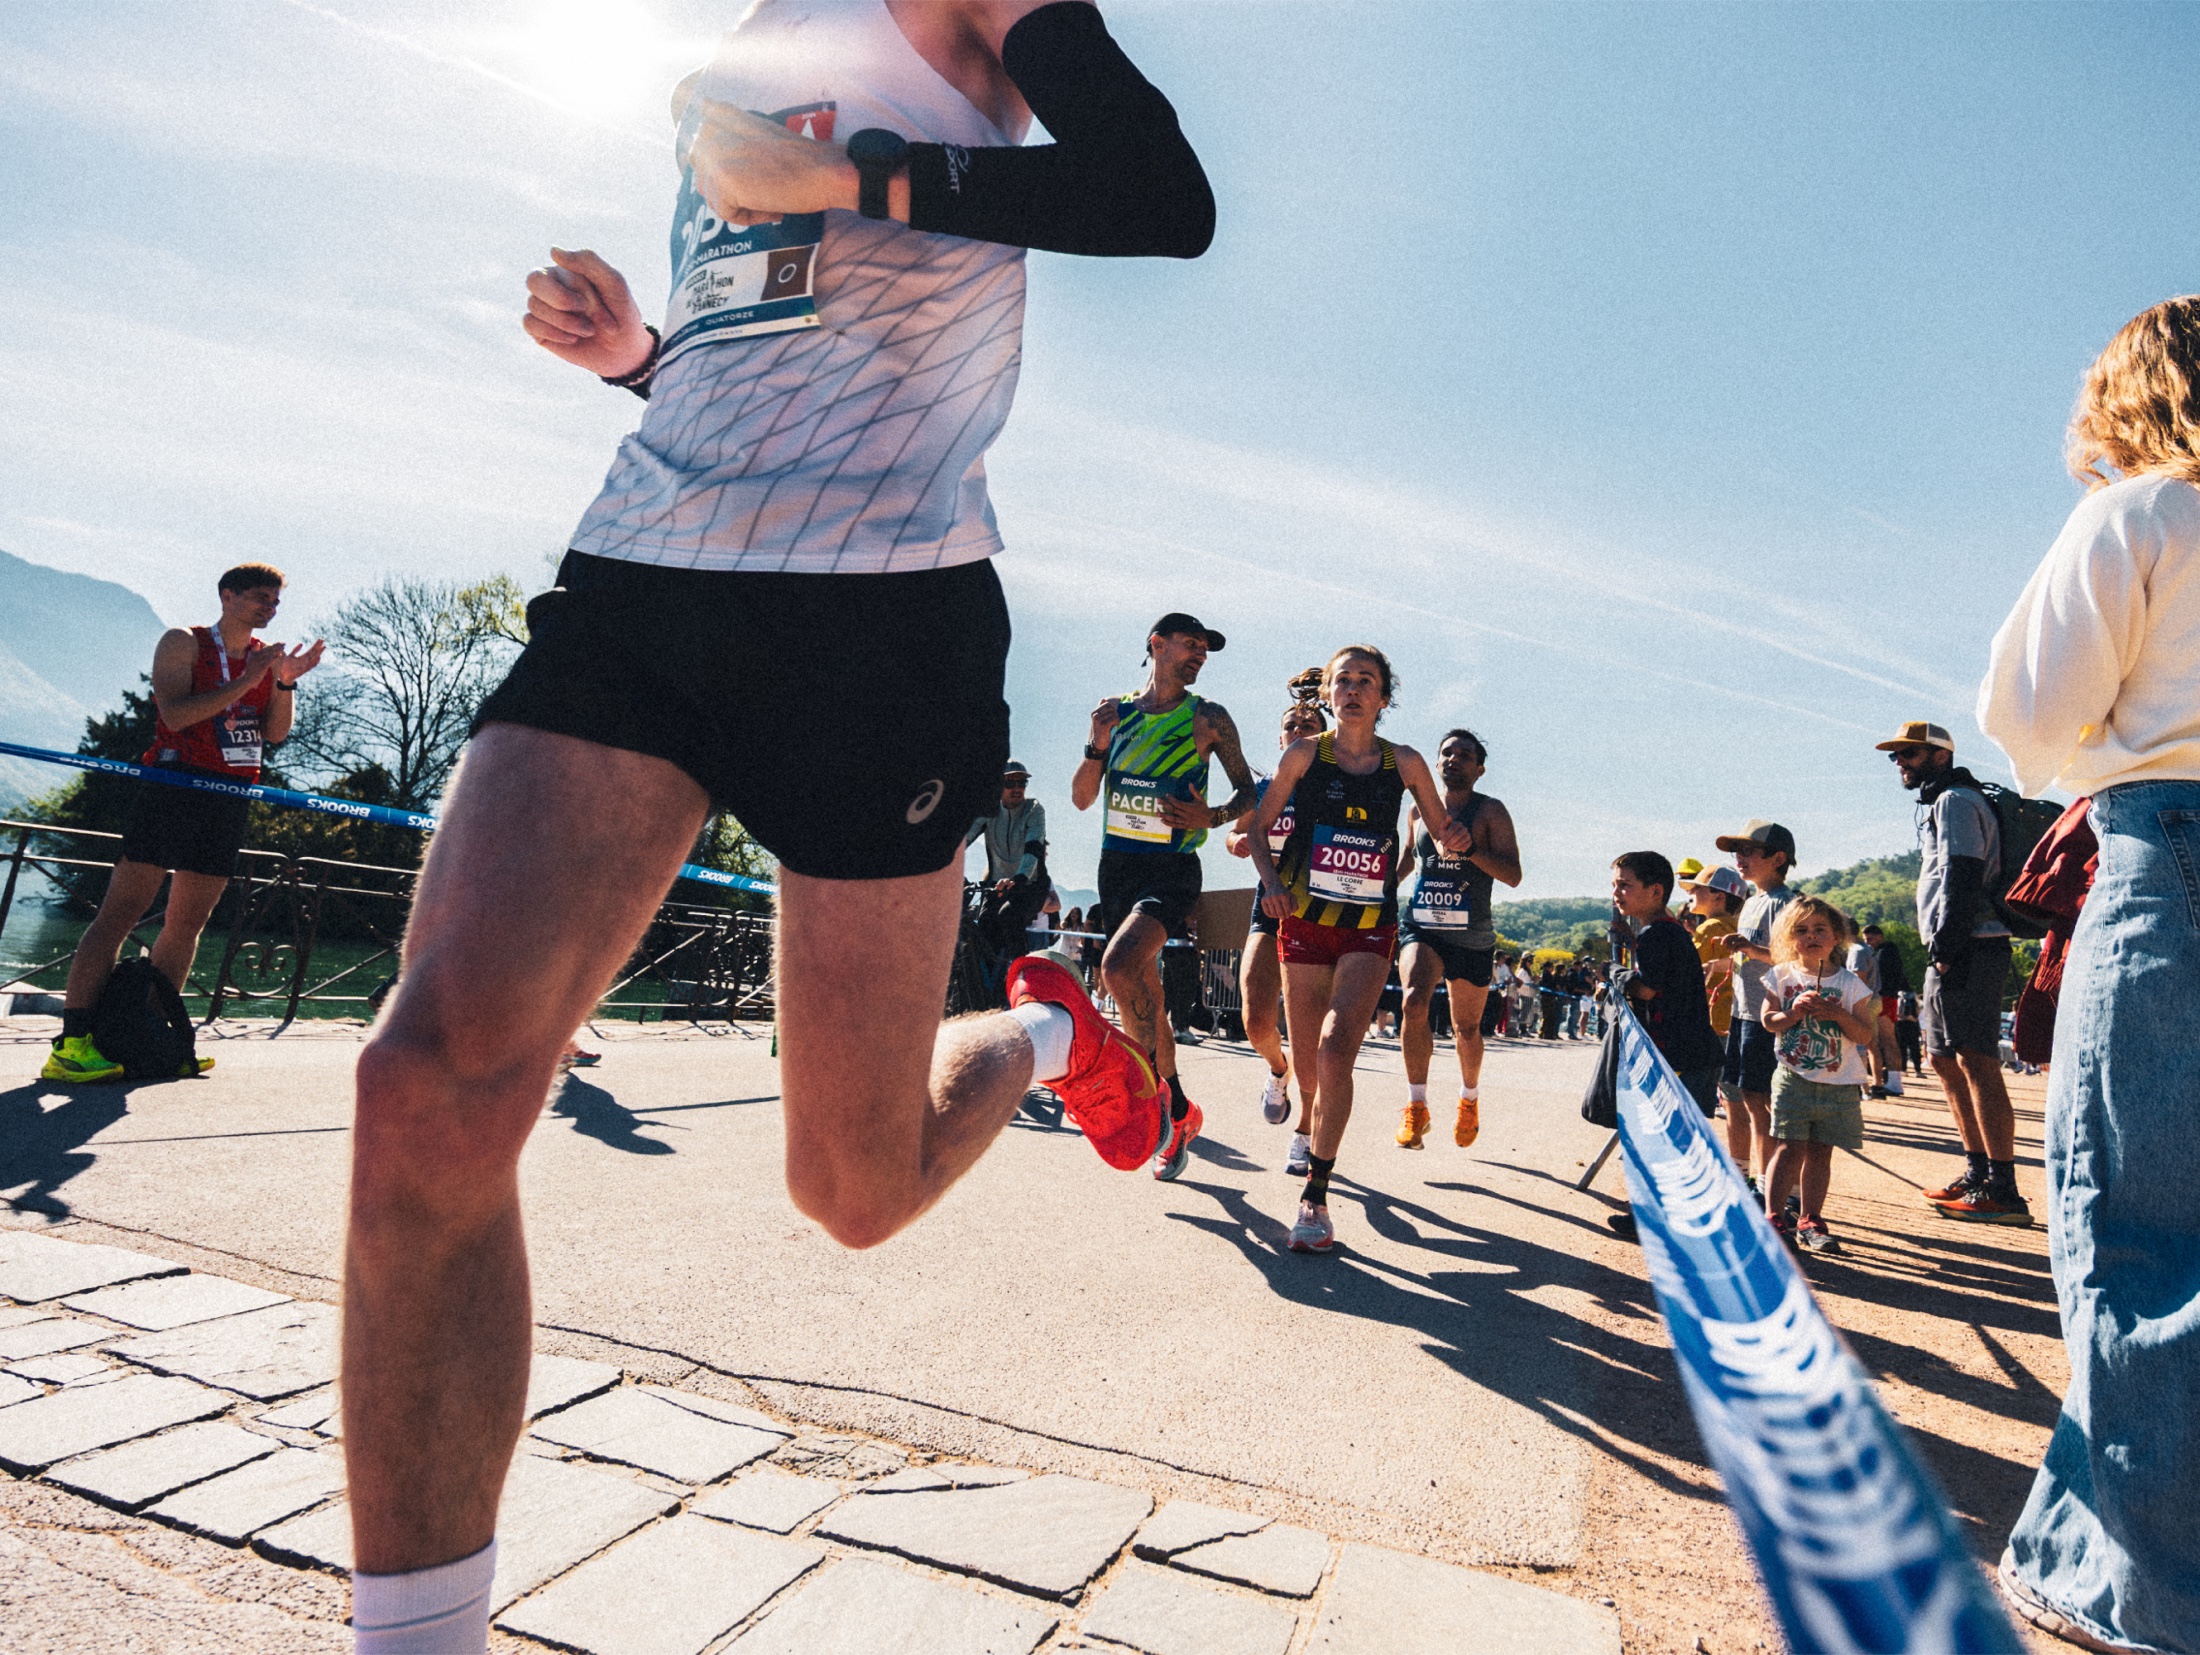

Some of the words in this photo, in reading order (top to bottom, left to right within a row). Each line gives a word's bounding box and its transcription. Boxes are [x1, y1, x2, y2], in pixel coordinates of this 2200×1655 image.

[193, 779, 264, 799] BROOKS
[1121, 777, 1158, 788] BROOKS
[306, 798, 371, 818] BROOKS
[407, 815, 438, 829] OKS
[1332, 833, 1377, 848] BROOKS
[1380, 837, 1393, 854] ELITE
[1320, 847, 1381, 874] 20056
[1438, 862, 1461, 871] MMC
[698, 870, 735, 884] BROOKS
[1424, 881, 1454, 889] BROOKS
[1417, 891, 1462, 907] 20009
